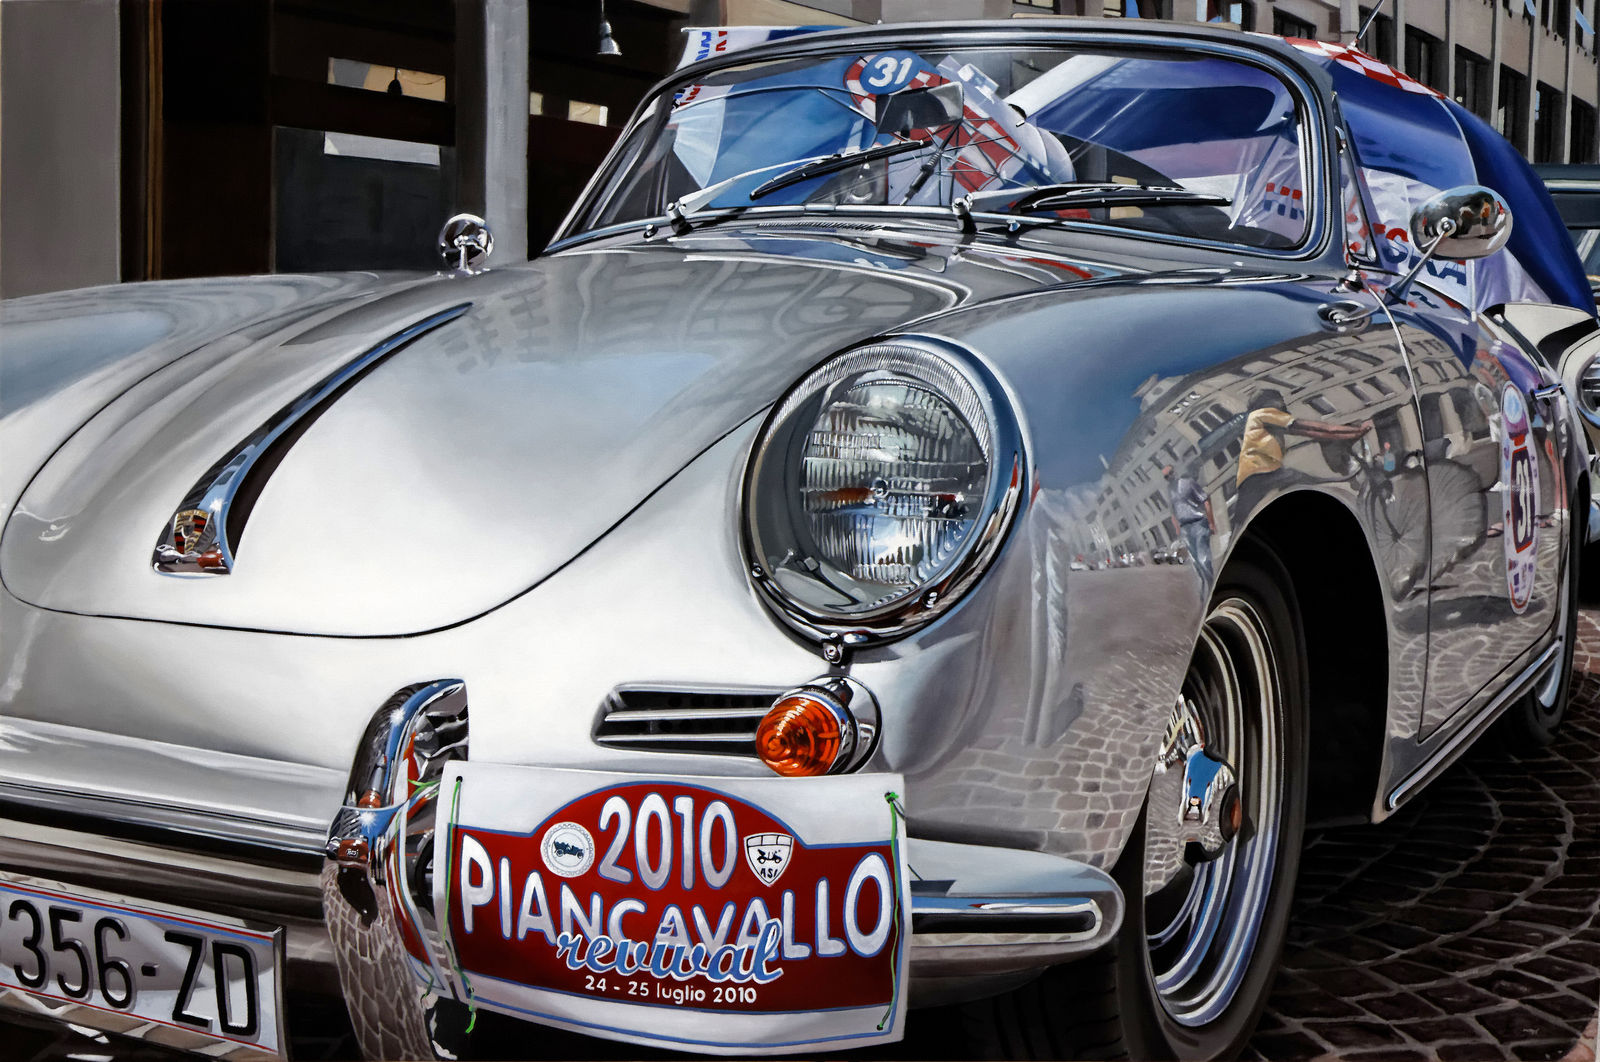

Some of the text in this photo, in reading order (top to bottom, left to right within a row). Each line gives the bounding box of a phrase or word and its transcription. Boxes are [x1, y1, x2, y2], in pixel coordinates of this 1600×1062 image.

[867, 55, 913, 89] 31
[1515, 458, 1532, 544] 31
[597, 793, 738, 891] 2010
[760, 867, 779, 879] ASI
[459, 833, 895, 959] PIANCAVALLO
[556, 917, 784, 984] revival
[584, 974, 607, 993] 24
[627, 980, 650, 997] 25
[656, 982, 706, 1005] luglio
[713, 986, 758, 1004] 2010
